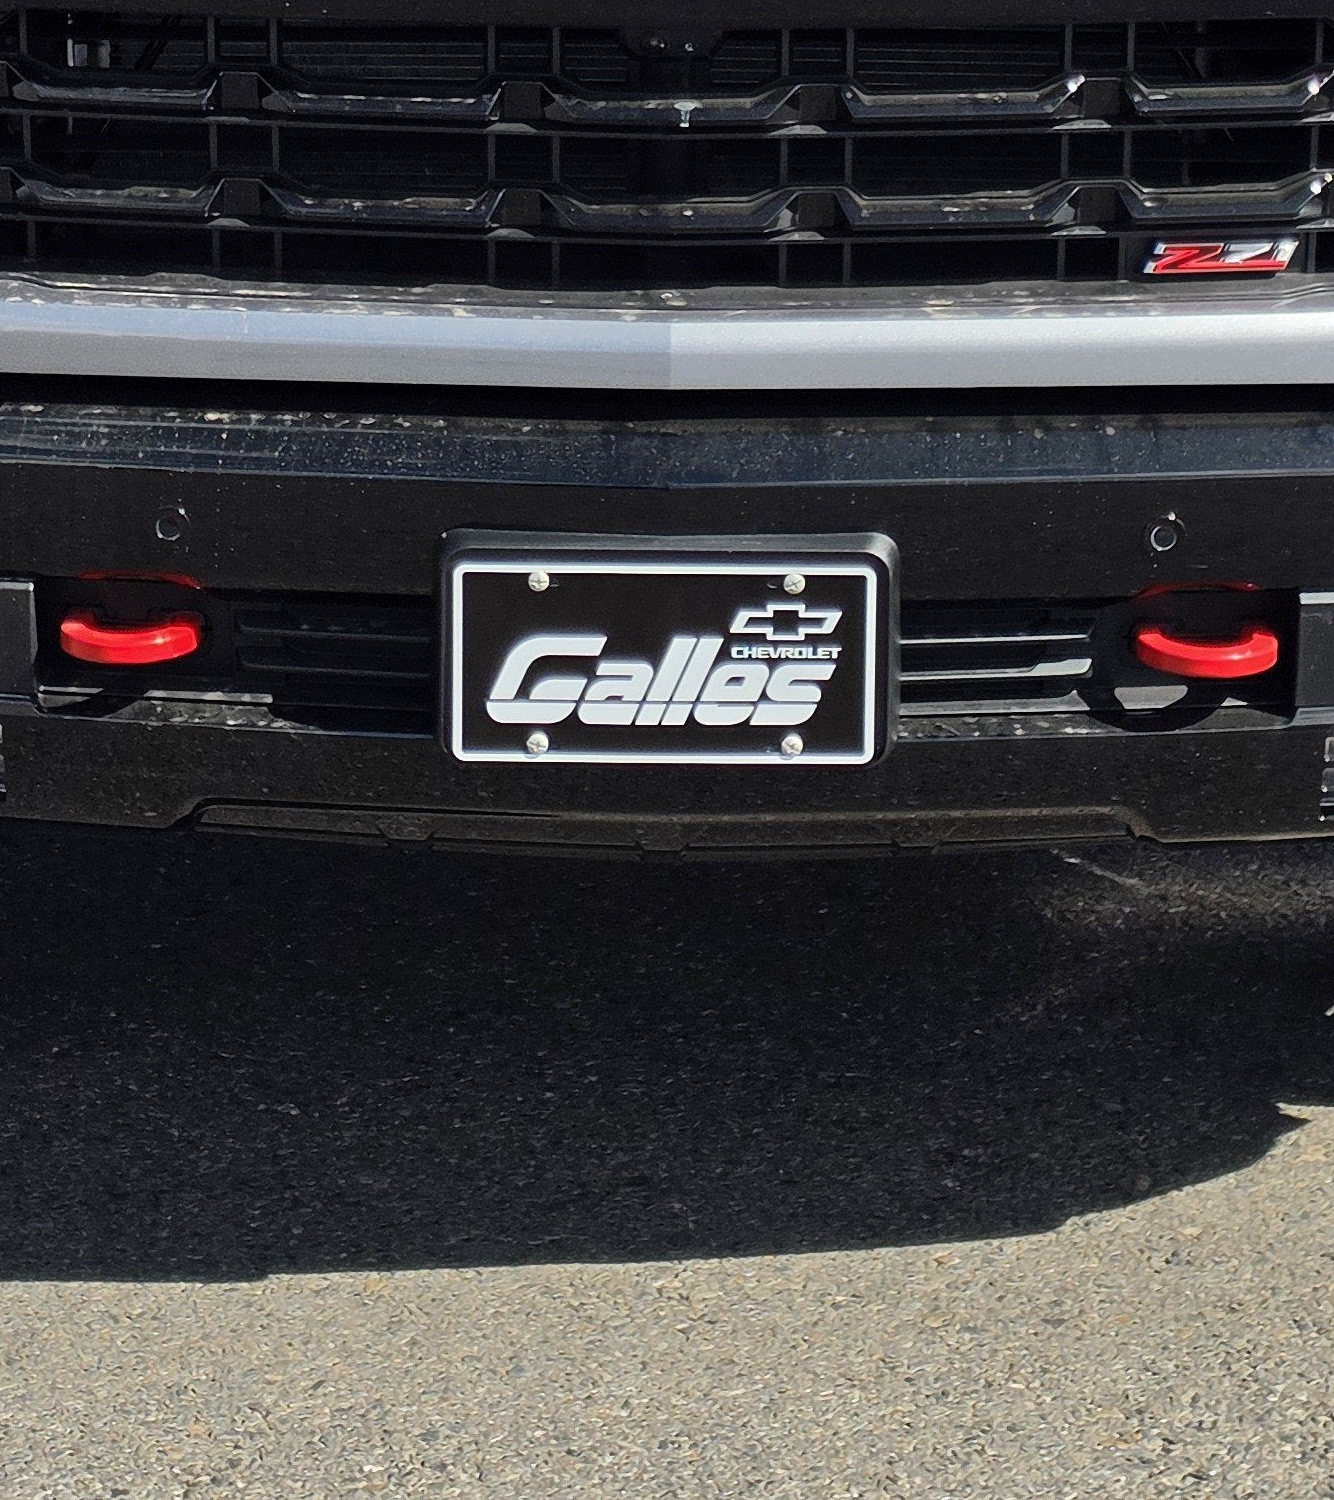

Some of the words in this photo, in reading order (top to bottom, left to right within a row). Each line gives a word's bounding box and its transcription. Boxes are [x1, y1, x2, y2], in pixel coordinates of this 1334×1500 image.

[1143, 240, 1300, 275] Z71
[731, 646, 842, 659] CHEVROLET
[485, 633, 837, 726] Galles
